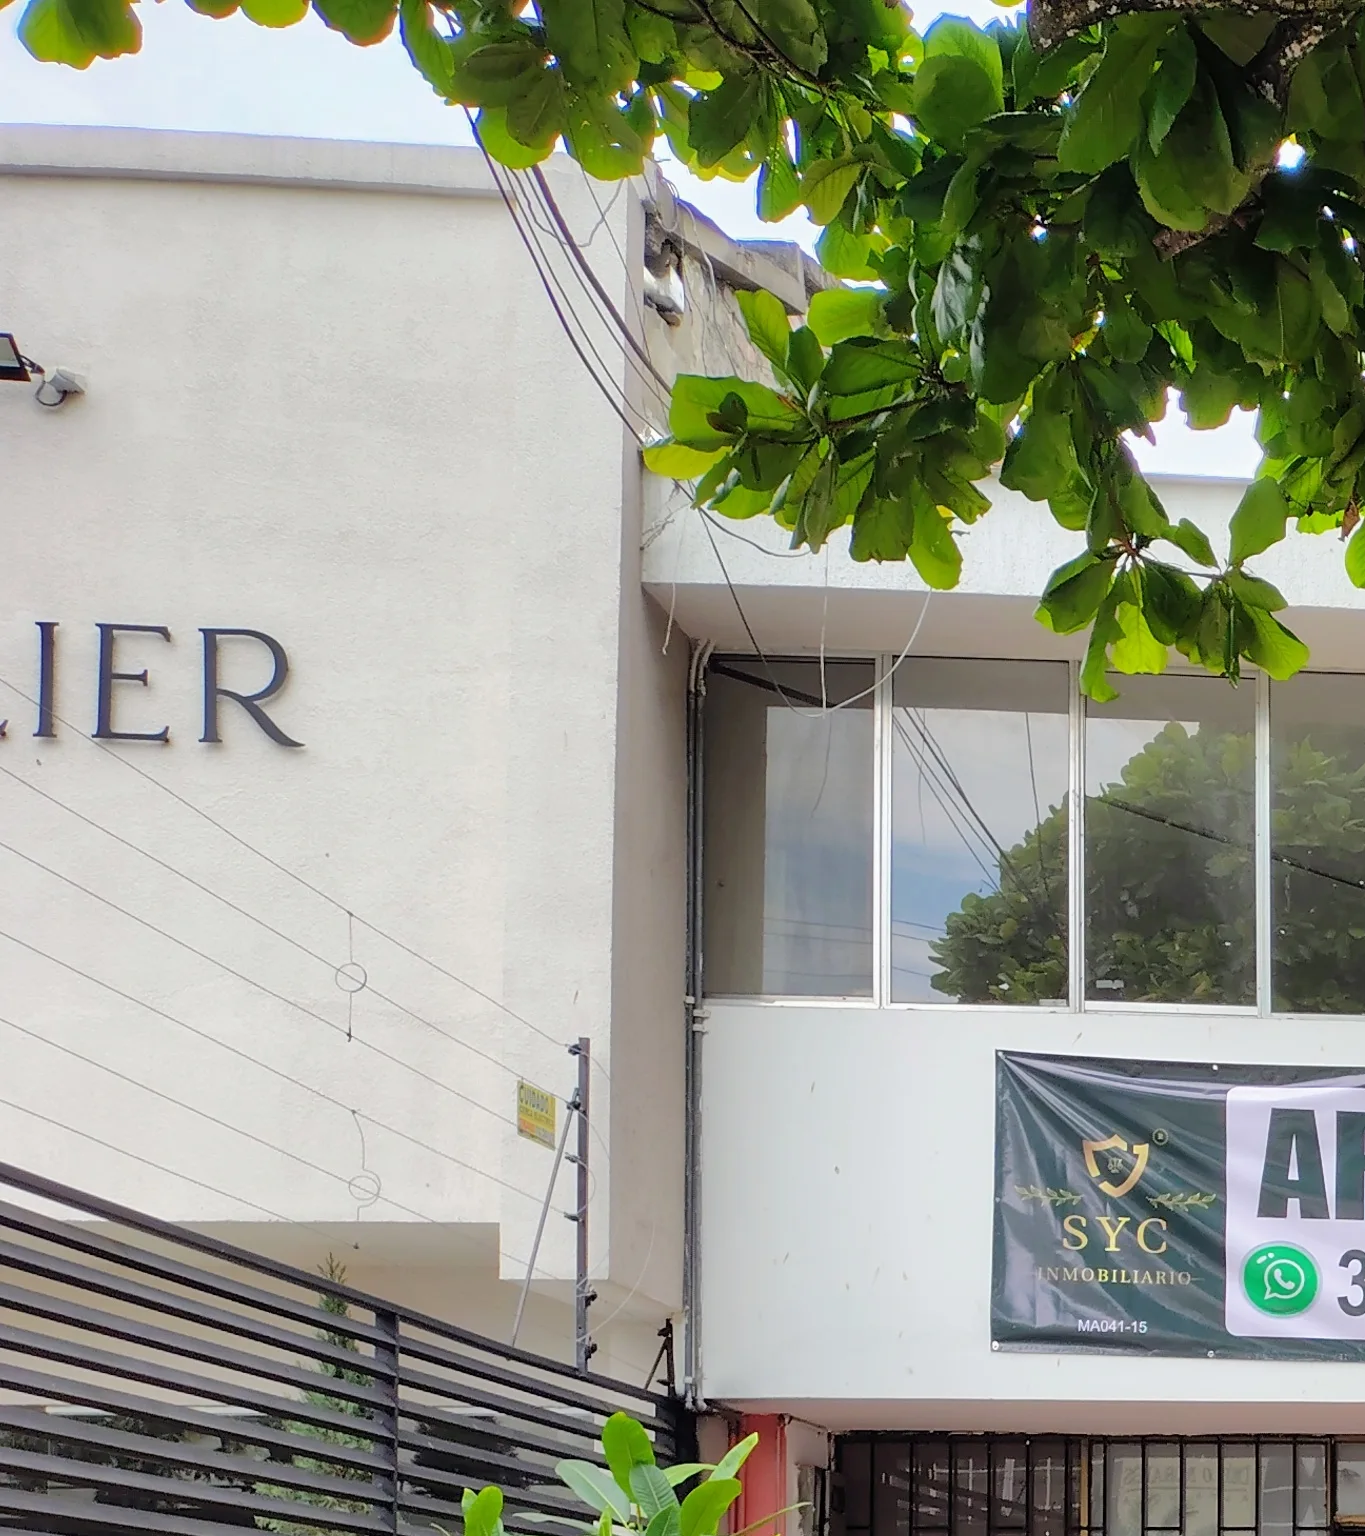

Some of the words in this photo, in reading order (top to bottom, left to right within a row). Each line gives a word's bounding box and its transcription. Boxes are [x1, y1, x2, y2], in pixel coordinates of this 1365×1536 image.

[0, 621, 305, 748] IER
[1062, 1214, 1168, 1254] SYC
[1037, 1267, 1192, 1286] INMOBILIARIO
[1077, 1319, 1148, 1334] MA041-15
